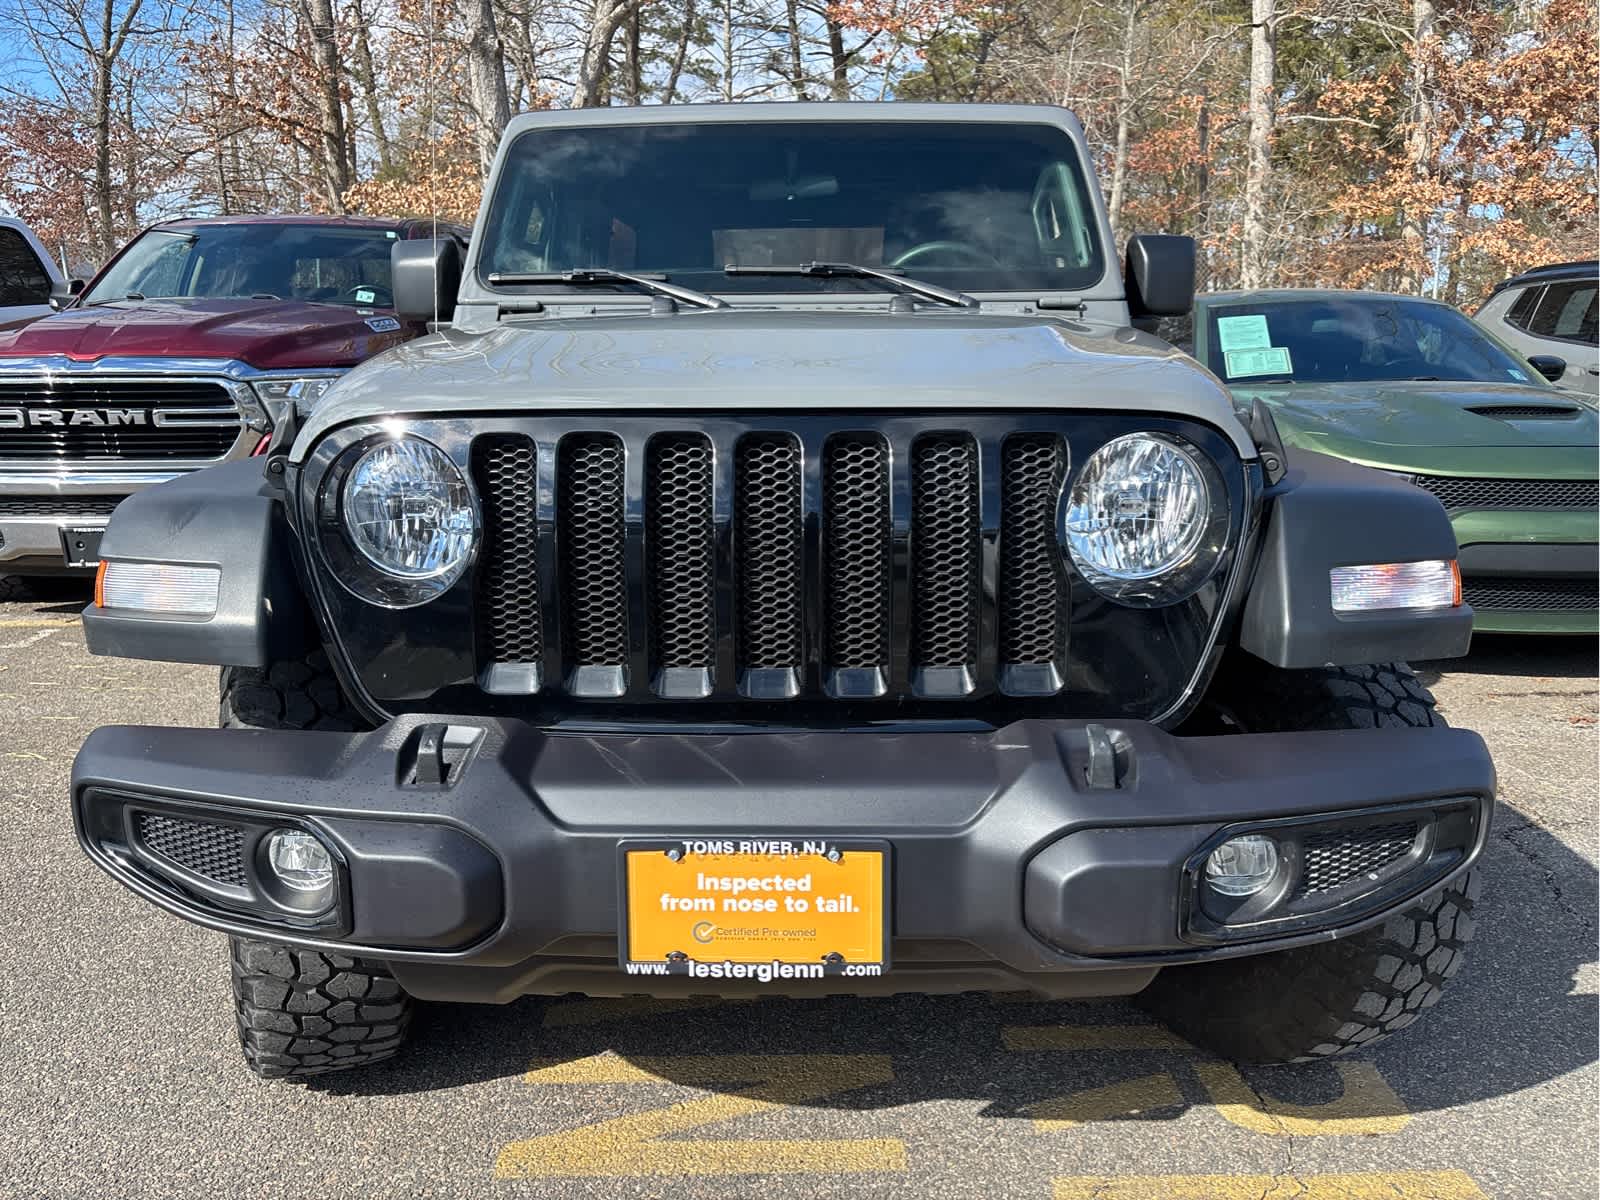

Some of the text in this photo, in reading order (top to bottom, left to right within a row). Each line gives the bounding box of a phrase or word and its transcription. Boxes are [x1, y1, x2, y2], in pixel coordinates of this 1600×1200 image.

[28, 408, 147, 426] RAM
[682, 841, 826, 855] TOMS RIVER, NJ
[697, 873, 812, 895] Inspected
[660, 894, 860, 912] from nose to tail.
[716, 928, 759, 936] Certified
[626, 960, 881, 982] www. lesterglenn .com
